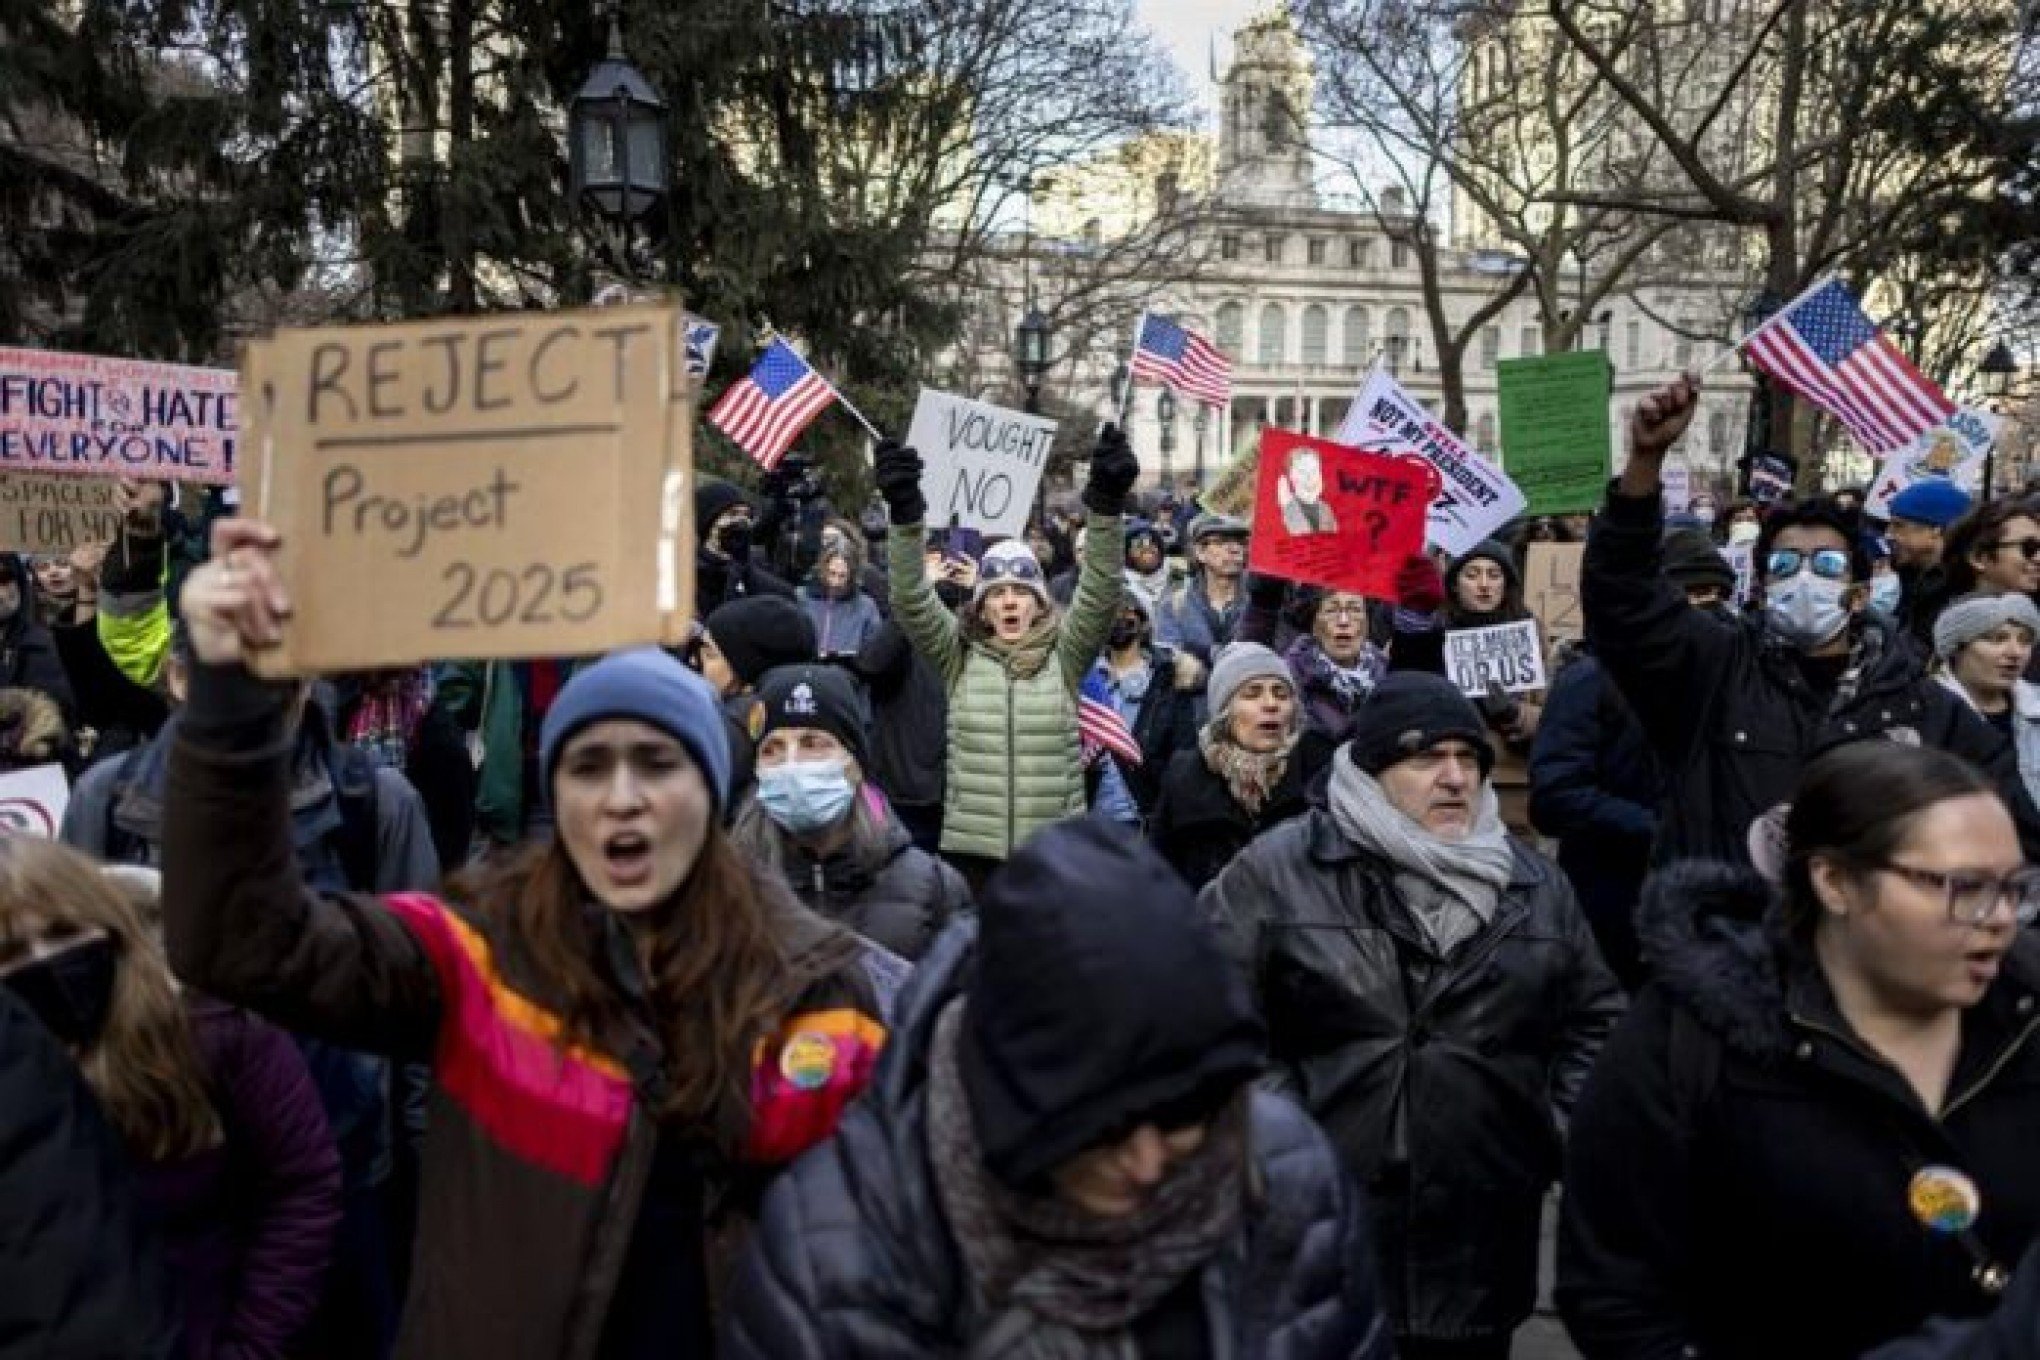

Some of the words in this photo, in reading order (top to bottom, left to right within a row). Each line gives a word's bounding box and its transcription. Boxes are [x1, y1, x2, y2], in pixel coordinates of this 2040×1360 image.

[308, 324, 650, 423] REJECT
[2, 374, 104, 420] FIGHT
[142, 385, 239, 432] HATE
[1, 429, 209, 467] EVERYONE
[949, 406, 1054, 467] VOUGHT
[1369, 397, 1408, 429] NOT
[1398, 420, 1427, 444] MY
[1421, 440, 1499, 507] PRESIDENT
[322, 463, 520, 558] Project
[949, 467, 1012, 519] NO
[1336, 469, 1410, 504] WTF
[18, 507, 74, 545] FOR
[81, 507, 119, 541] YO
[1363, 510, 1389, 552] ?
[431, 561, 603, 629] 2025
[1456, 660, 1490, 692] OR
[1498, 654, 1536, 687] US
